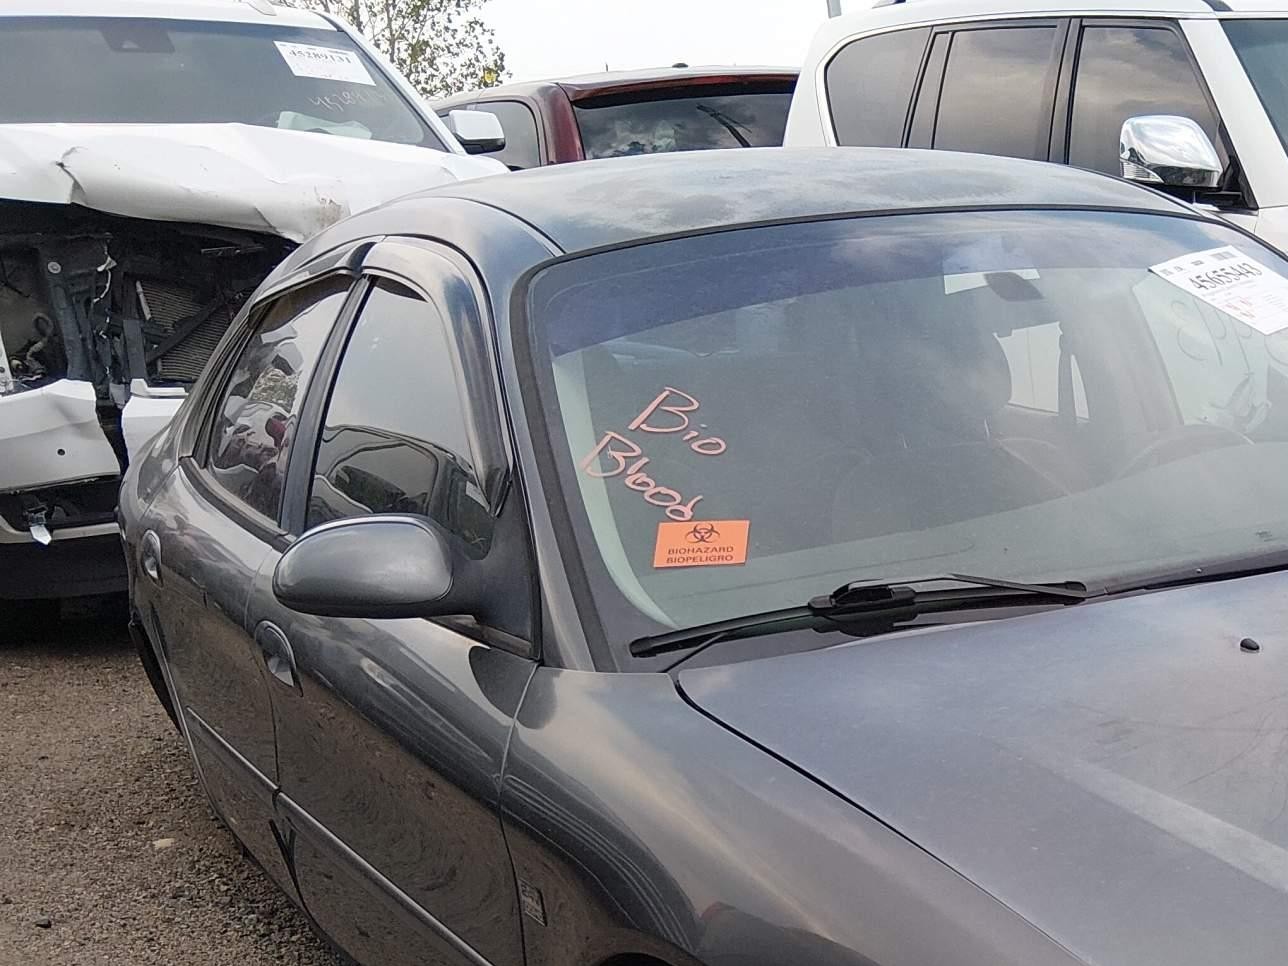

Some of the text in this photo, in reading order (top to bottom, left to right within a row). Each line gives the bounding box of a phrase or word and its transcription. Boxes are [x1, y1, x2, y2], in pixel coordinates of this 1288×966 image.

[1188, 262, 1263, 291] 45655443
[628, 386, 727, 456] Bio
[580, 430, 704, 522] Blood
[666, 554, 734, 565] BIOPELIGRO
[667, 545, 735, 556] BIOHAZARD
